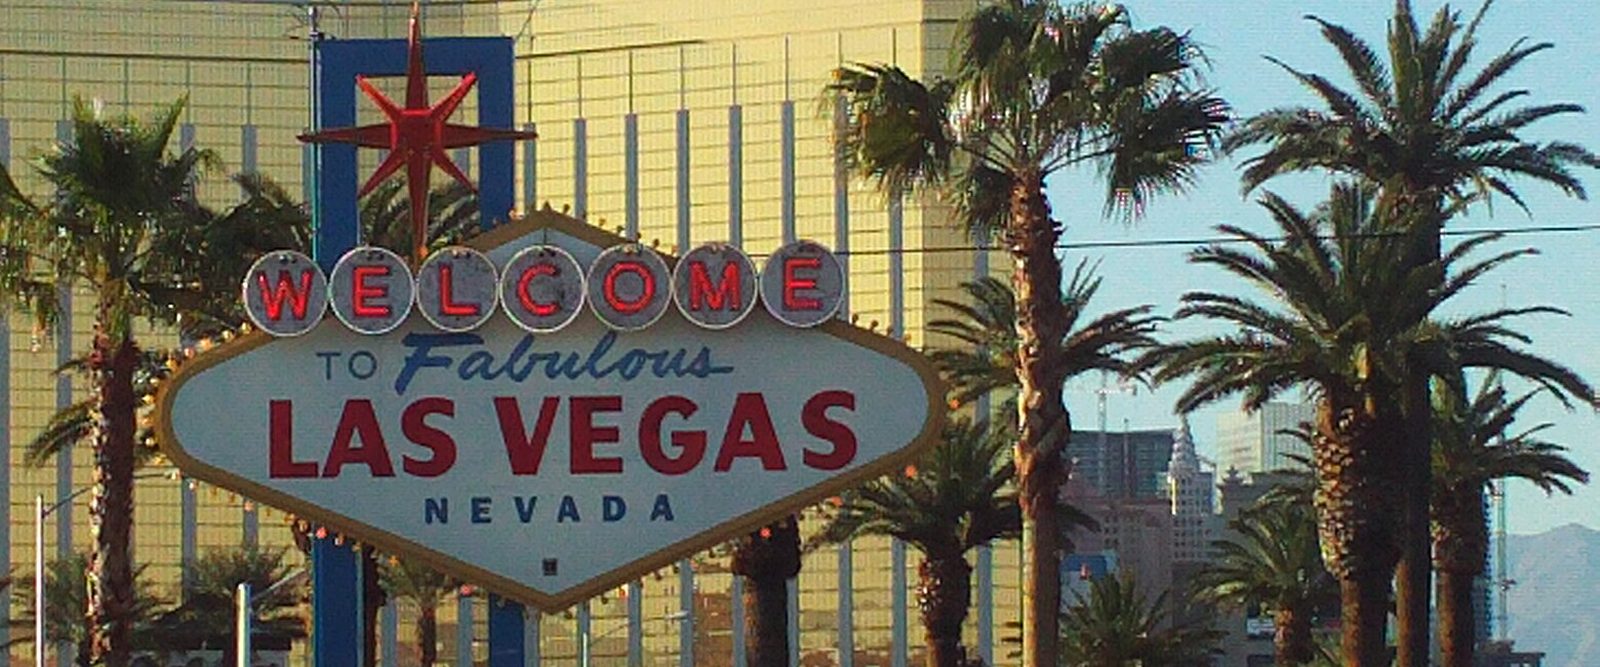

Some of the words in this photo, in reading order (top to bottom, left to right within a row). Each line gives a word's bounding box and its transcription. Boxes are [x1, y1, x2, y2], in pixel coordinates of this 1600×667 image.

[256, 254, 824, 321] WELCOME
[317, 351, 378, 382] TO
[395, 332, 734, 396] Fabulous
[268, 397, 458, 479] LAS
[494, 390, 858, 476] VEGAS
[424, 494, 676, 525] NEVADA
